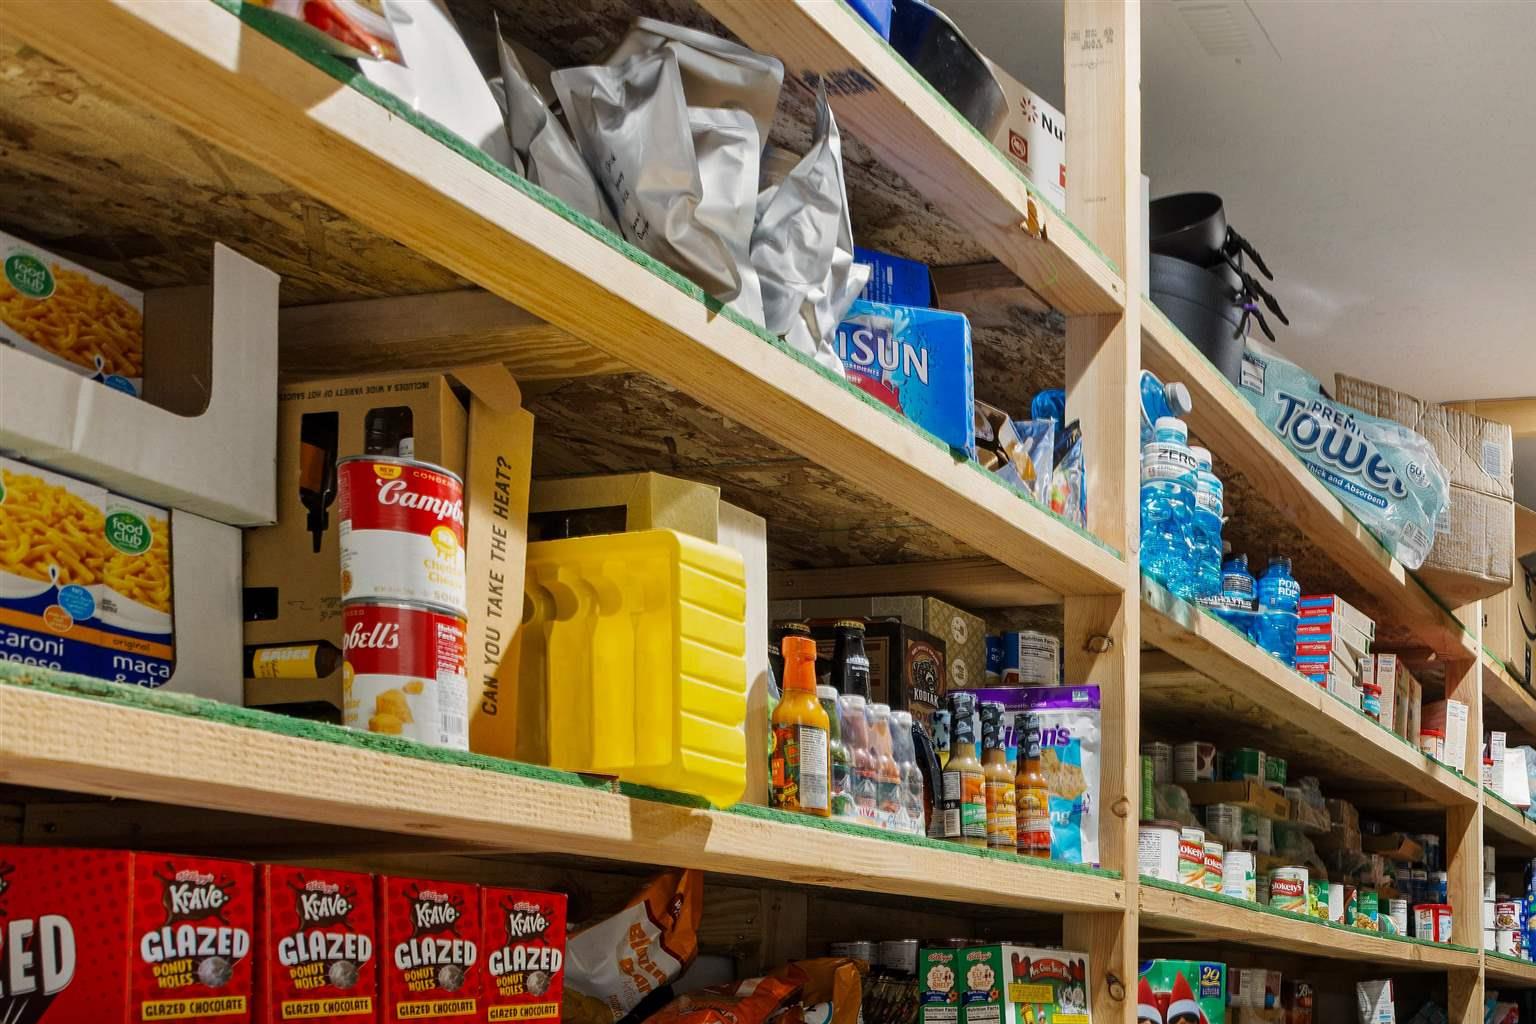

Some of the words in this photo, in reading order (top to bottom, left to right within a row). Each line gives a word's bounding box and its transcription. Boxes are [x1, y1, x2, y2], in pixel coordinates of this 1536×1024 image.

[494, 457, 513, 520] HEAT?
[112, 517, 143, 536] food
[113, 530, 142, 547] club
[491, 525, 507, 560] THE
[487, 570, 504, 623] TAKE
[112, 637, 150, 651] original
[484, 627, 501, 667] YOU
[482, 674, 498, 716] CAN
[914, 688, 939, 706] KODIAK
[140, 925, 250, 963] GLAZED
[278, 931, 372, 966] GLAZED
[394, 937, 477, 970] GLAZED
[153, 959, 193, 977] DONUT
[489, 945, 562, 976] GLAZED
[158, 974, 194, 989] HOLES
[290, 964, 324, 980] DONUT
[294, 976, 325, 989] HOLES
[145, 1000, 186, 1017] GLAZED
[190, 998, 243, 1014] CHOCOLATE
[323, 1000, 369, 1013] CHOCOLATE
